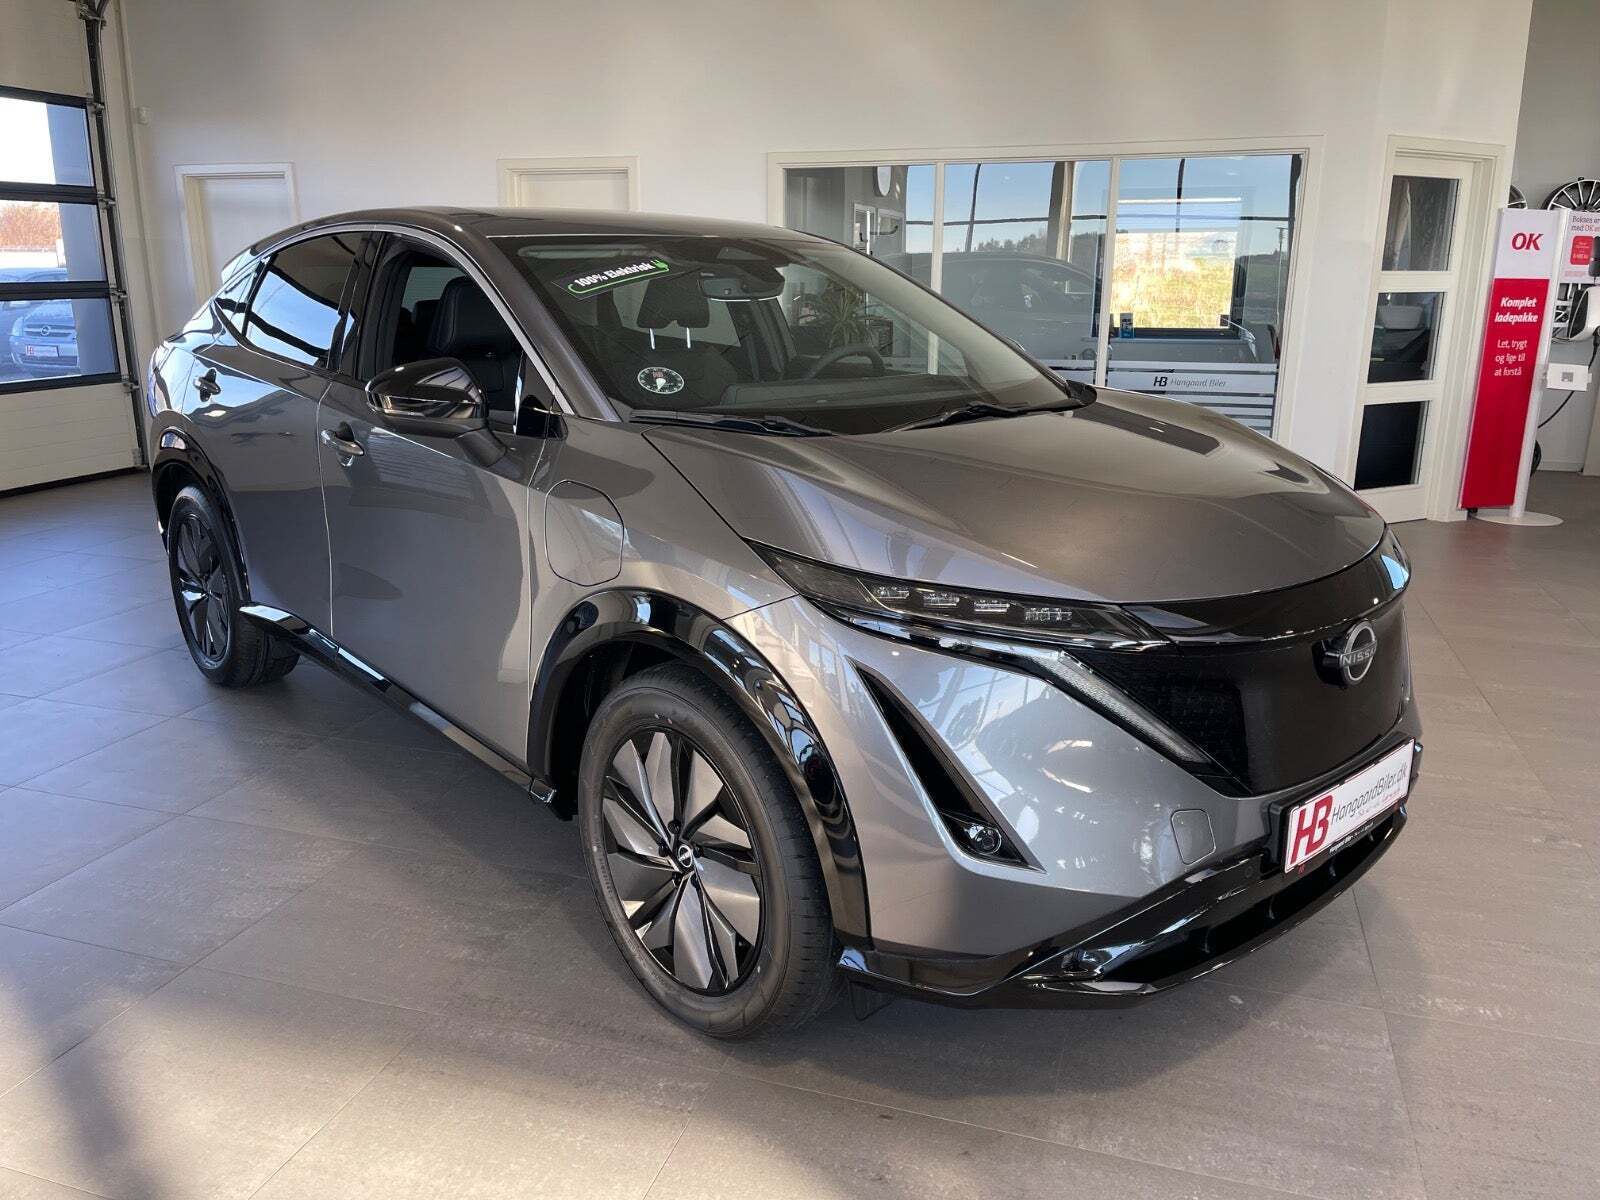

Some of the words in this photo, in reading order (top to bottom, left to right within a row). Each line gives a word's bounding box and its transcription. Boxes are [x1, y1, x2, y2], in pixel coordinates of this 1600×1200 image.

[1511, 232, 1544, 251] OK
[574, 273, 608, 287] 100%
[603, 262, 655, 279] Elektrisk
[1500, 296, 1537, 310] Komplet
[1494, 311, 1539, 326] ladepakke
[1497, 339, 1510, 349] Let,
[1511, 339, 1528, 350] trygt
[1495, 355, 1505, 365] og
[1506, 353, 1517, 364] lige
[1518, 352, 1526, 362] til
[1494, 367, 1502, 377] at
[1503, 366, 1522, 377] forstå
[1153, 376, 1168, 387] HB
[1290, 793, 1334, 865] HB
